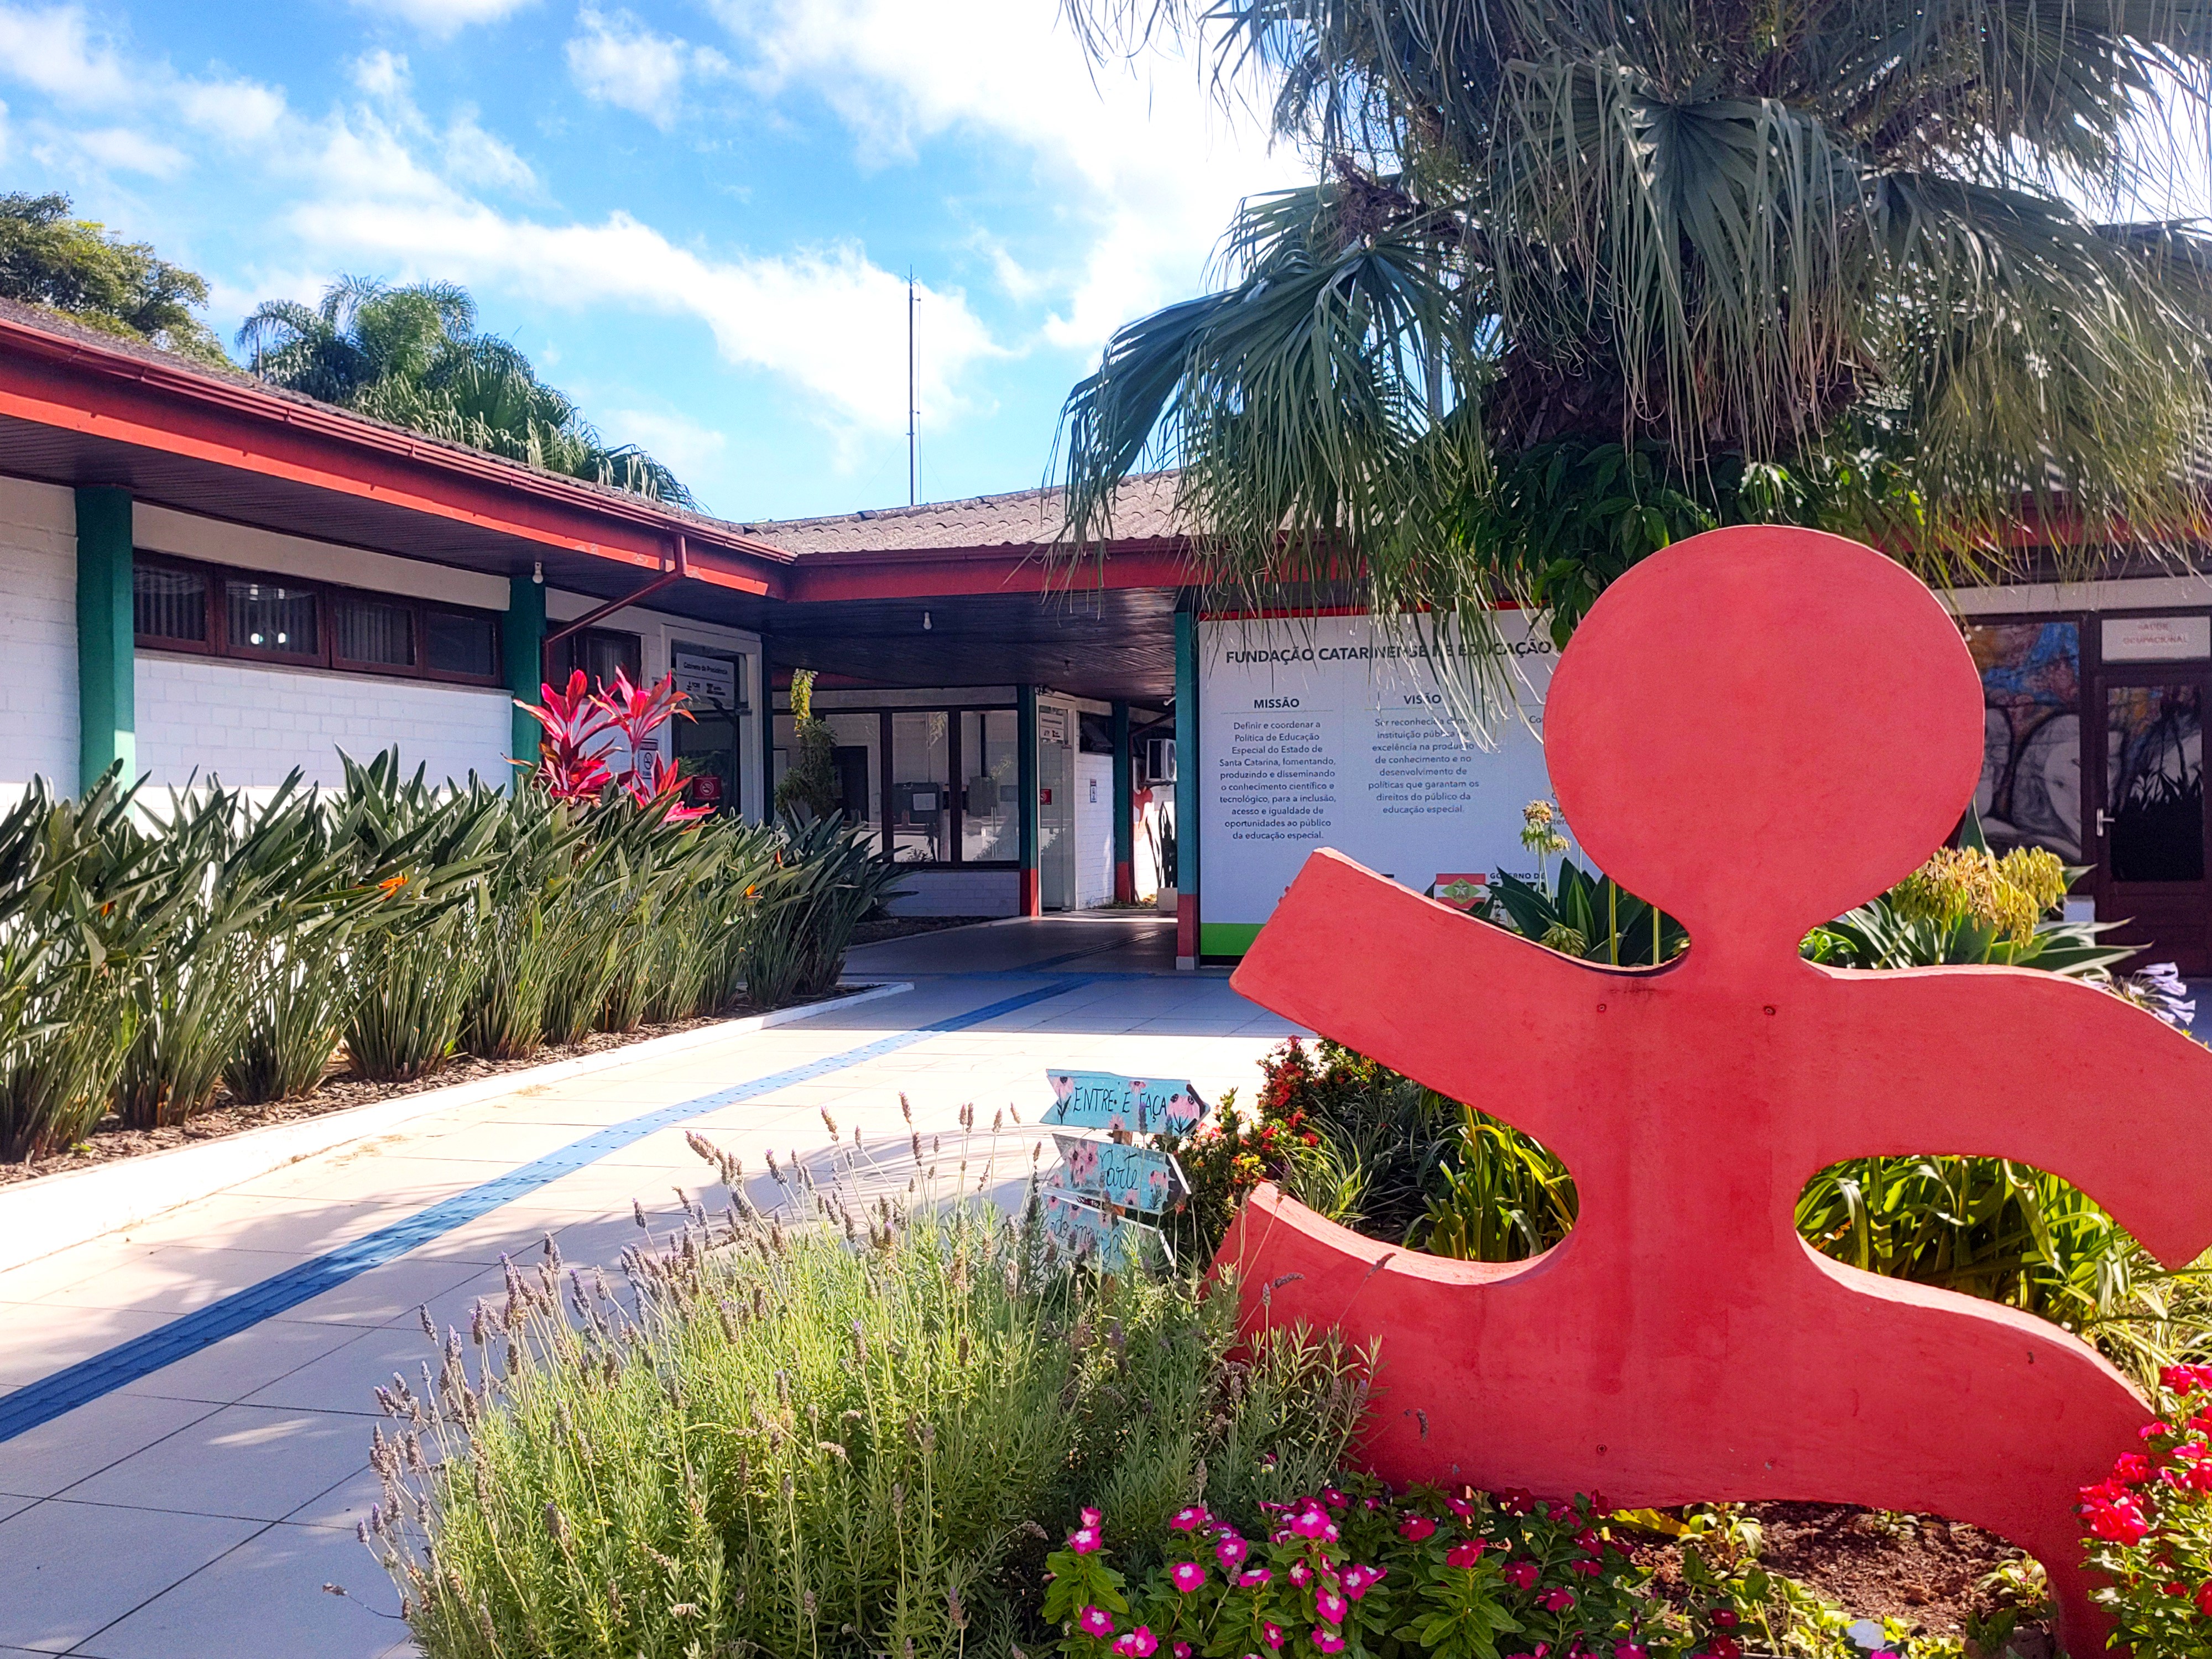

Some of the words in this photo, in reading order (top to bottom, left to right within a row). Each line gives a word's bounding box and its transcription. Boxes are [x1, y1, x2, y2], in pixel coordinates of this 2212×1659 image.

[1226, 646, 1314, 665] FUNDAÇÃO
[1254, 697, 1300, 708] MISSÃO
[1404, 693, 1442, 705] VISÃO
[1271, 721, 1313, 729] coordenar
[1279, 733, 1319, 742] Educação
[1378, 731, 1421, 740] instituição
[1232, 746, 1265, 755] Especial
[1281, 745, 1310, 753] Estado
[1372, 743, 1417, 752] excelência
[1244, 758, 1280, 766] Catarina,
[1282, 757, 1336, 765] fomentando,
[1220, 770, 1267, 779] produzindo
[1277, 770, 1335, 778] disseminando
[1379, 768, 1453, 776] desenvolvimento
[1289, 781, 1327, 790] científico
[1368, 781, 1404, 790] políticas
[1425, 781, 1466, 790] garantam
[1219, 795, 1270, 804] tecnológico,
[1300, 794, 1336, 802] inclusão,
[1376, 792, 1408, 801] direitos
[1411, 792, 1422, 801] do
[1425, 792, 1457, 802] público
[1269, 806, 1311, 816] igualdade
[1383, 805, 1425, 815] educação
[1426, 805, 1464, 815] especial.
[1224, 819, 1285, 828] oportunidades
[1300, 818, 1331, 828] público
[1245, 831, 1285, 841] educação
[1287, 831, 1323, 840] especial.
[1073, 1087, 1115, 1113] ENTRE
[1122, 1092, 1131, 1113] E
